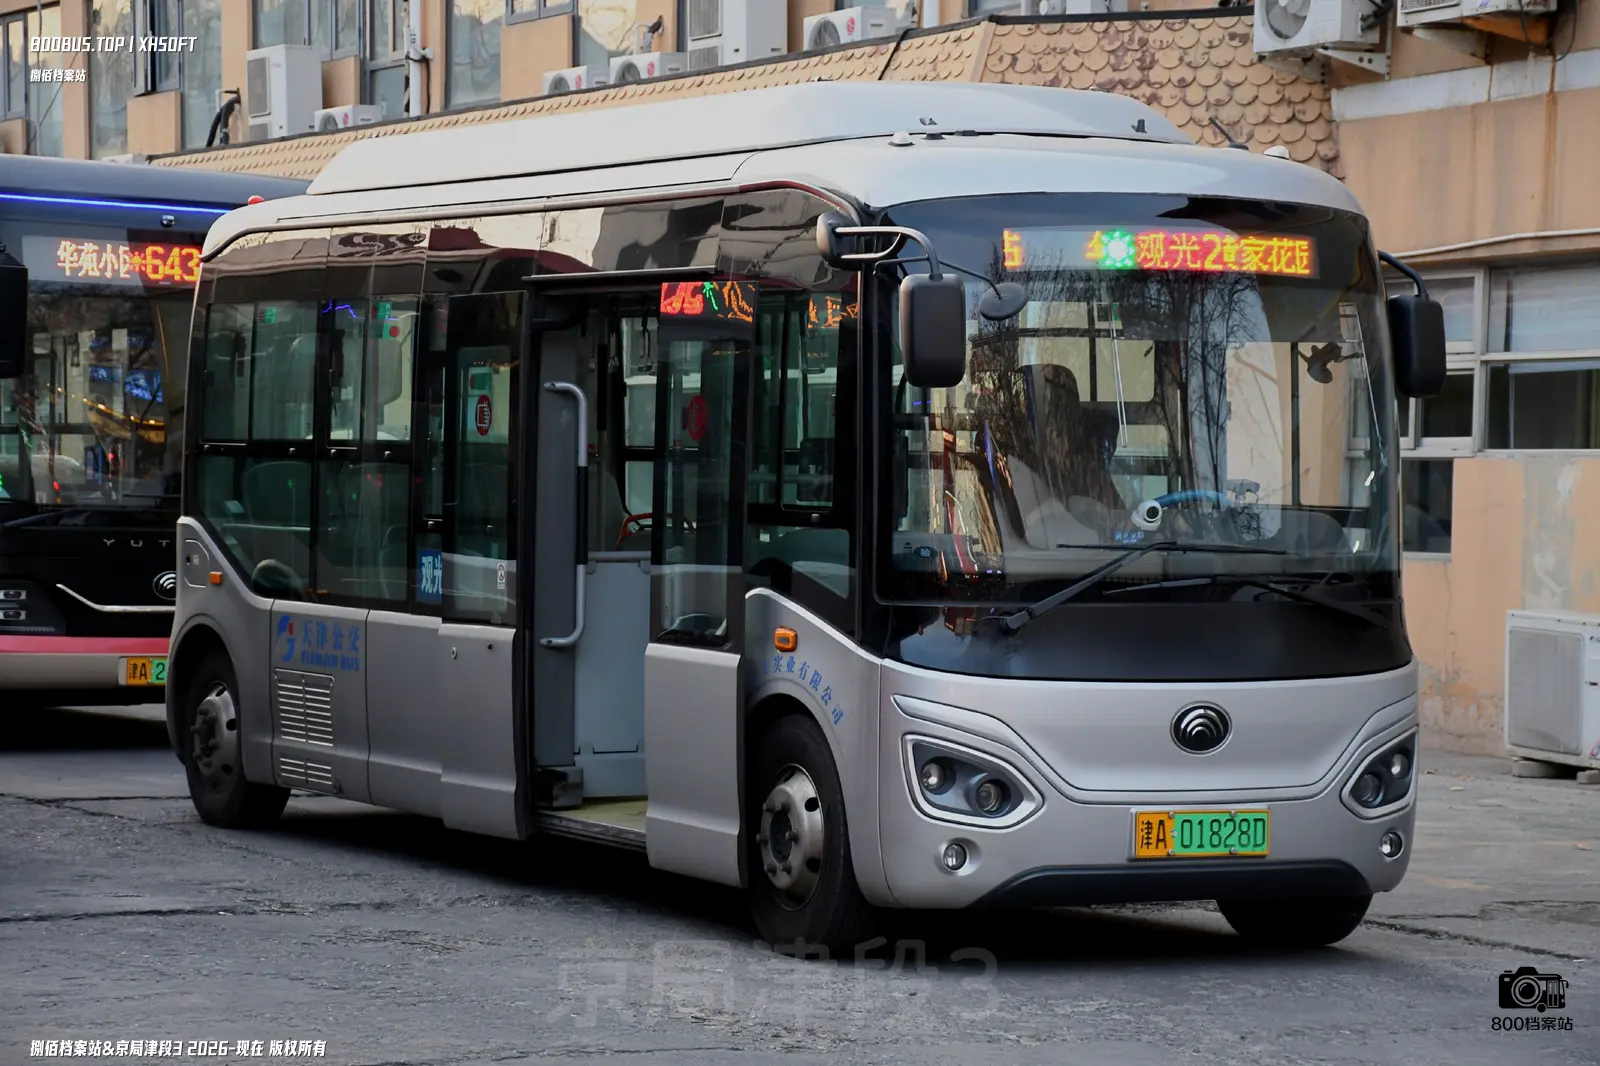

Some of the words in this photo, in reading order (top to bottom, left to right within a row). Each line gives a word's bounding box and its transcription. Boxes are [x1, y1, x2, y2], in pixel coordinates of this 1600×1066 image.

[145, 245, 200, 281] 643
[763, 654, 844, 725] 实业有限公司
